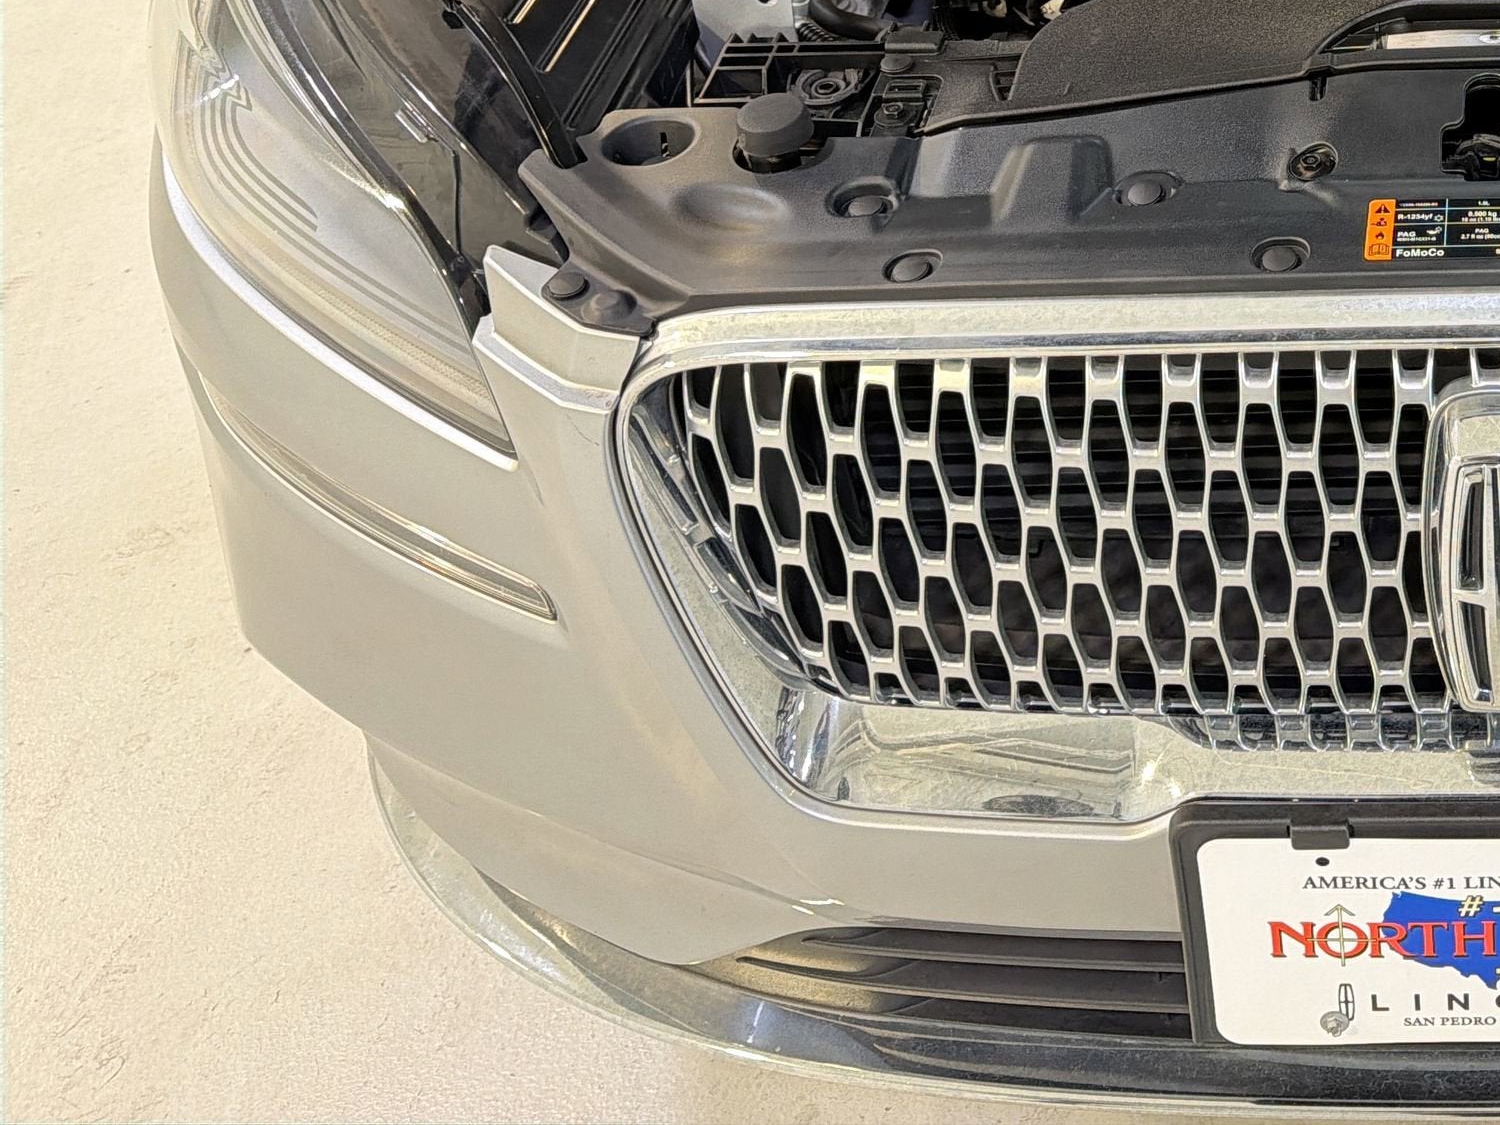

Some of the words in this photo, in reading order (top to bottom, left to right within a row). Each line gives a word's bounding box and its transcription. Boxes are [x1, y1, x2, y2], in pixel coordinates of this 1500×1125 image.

[1397, 213, 1433, 221] R-1234yf
[1467, 210, 1487, 218] 0.500
[1487, 210, 1498, 219] kg
[1395, 248, 1445, 257] FoMoCo
[1302, 875, 1427, 890] AMERICA'S
[1432, 876, 1457, 889] #1
[1267, 920, 1497, 958] NORTH
[1403, 1016, 1436, 1027] SAN
[1440, 1015, 1497, 1026] PEDRO
